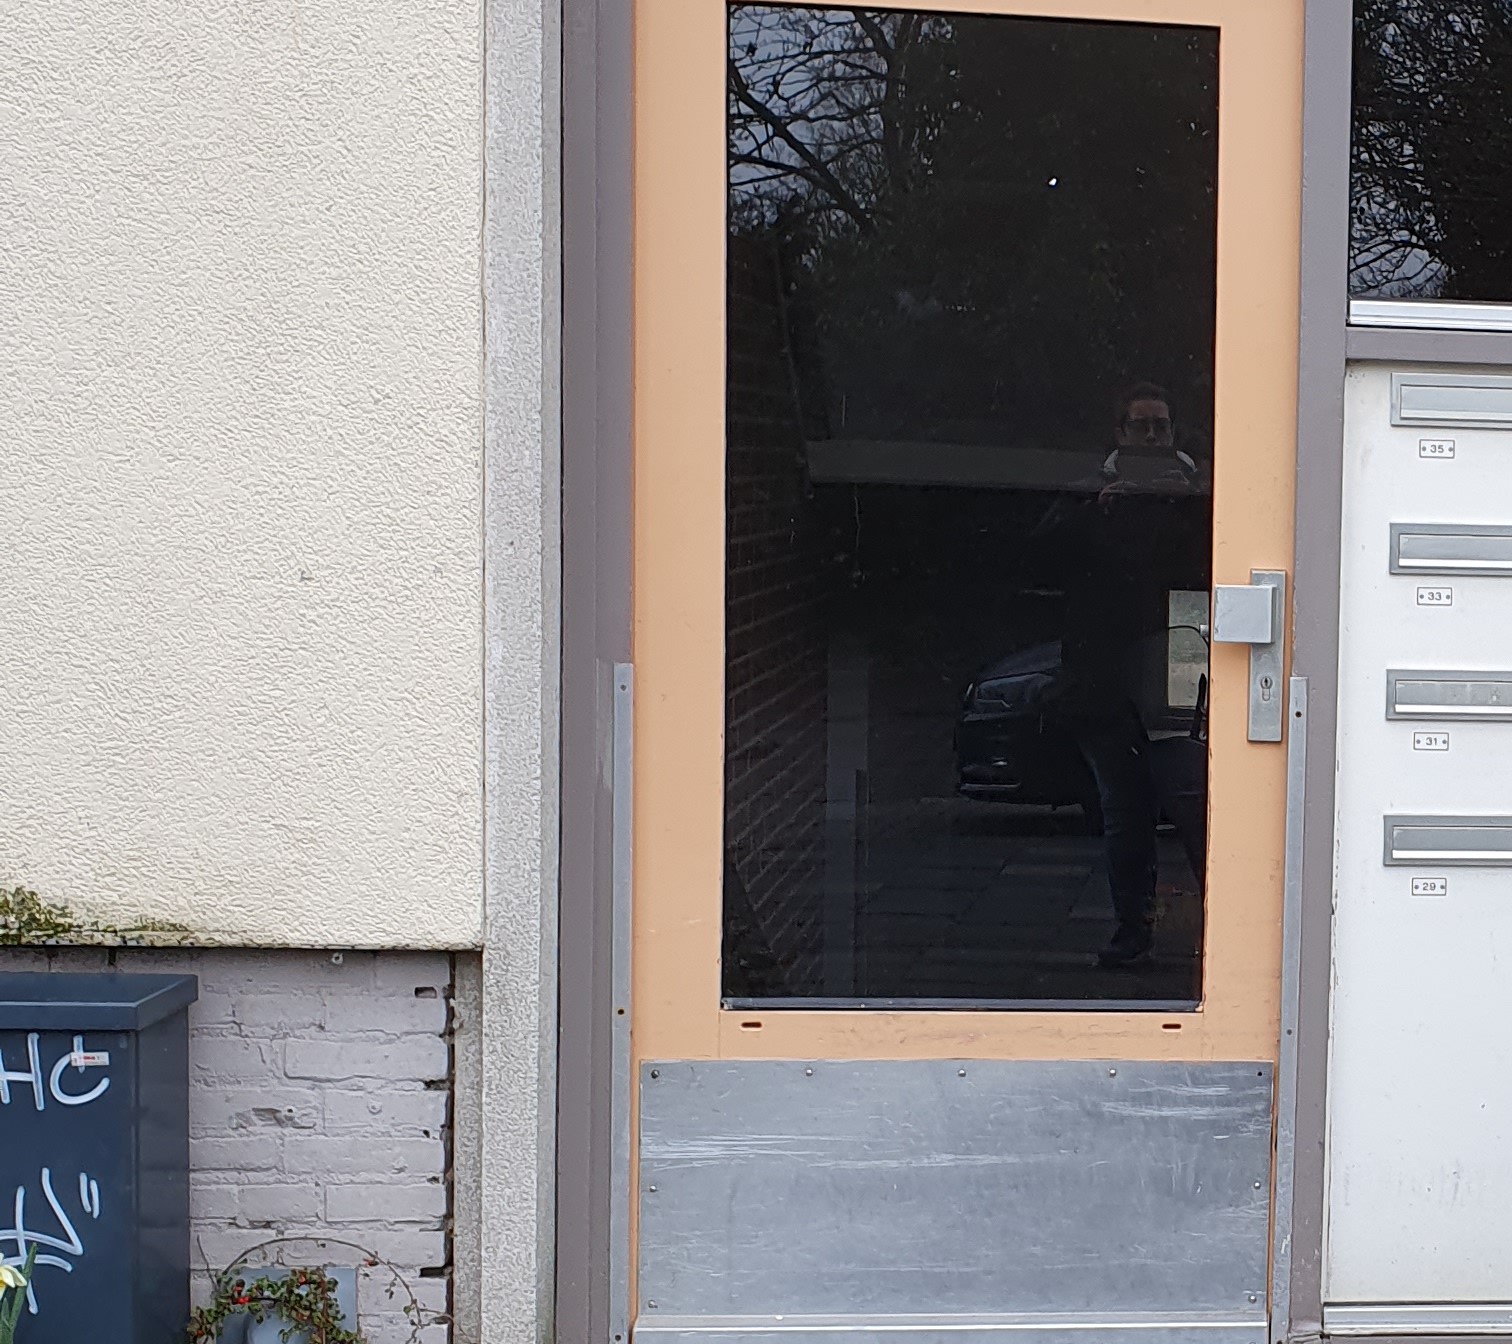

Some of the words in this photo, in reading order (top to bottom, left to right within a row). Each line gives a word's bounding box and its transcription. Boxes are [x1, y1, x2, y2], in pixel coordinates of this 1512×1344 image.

[1429, 444, 1445, 454] 35
[1427, 591, 1442, 602] 33
[1425, 736, 1438, 746] 31
